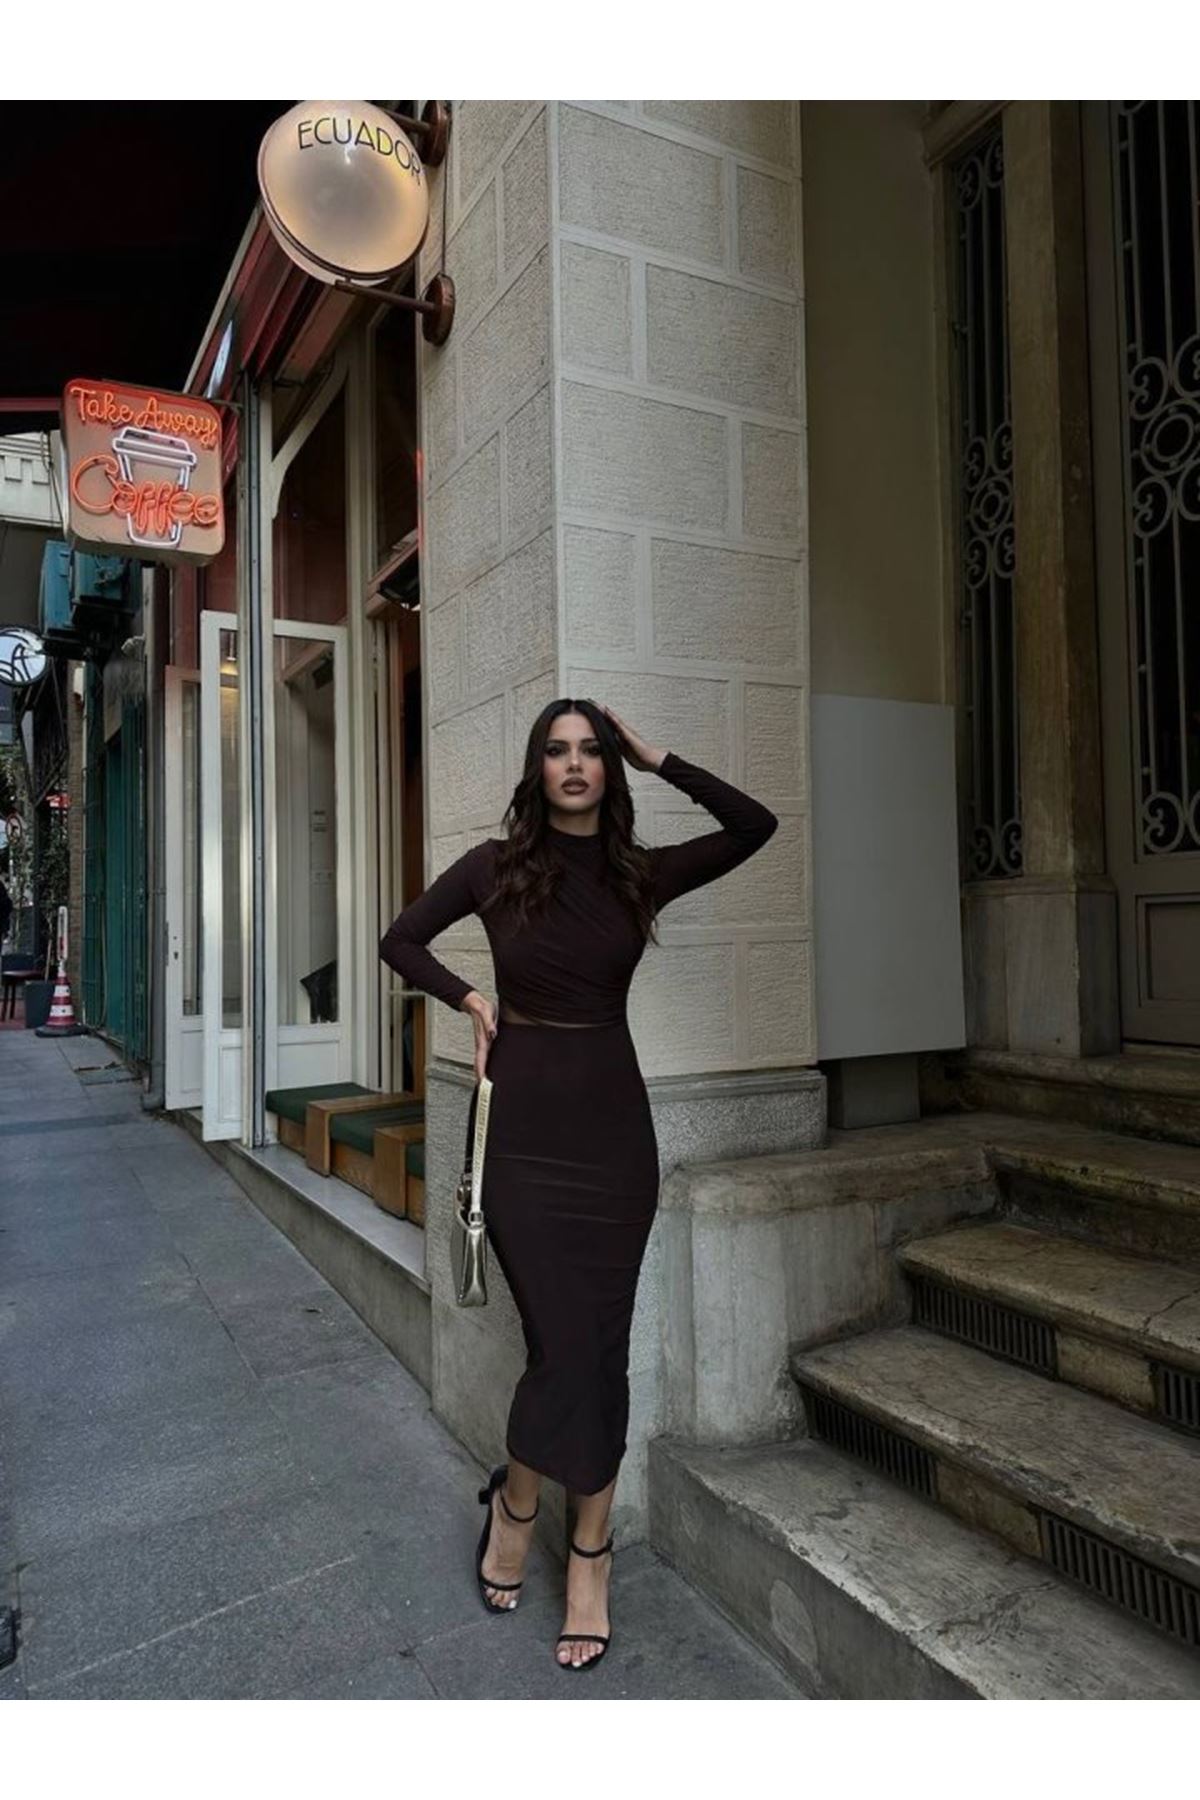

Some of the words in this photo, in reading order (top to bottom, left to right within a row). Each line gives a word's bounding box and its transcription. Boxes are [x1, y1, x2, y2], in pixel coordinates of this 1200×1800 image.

[297, 117, 422, 186] ECUADOR
[70, 387, 133, 423] Take
[135, 397, 219, 446] Away
[72, 454, 219, 535] Coffee
